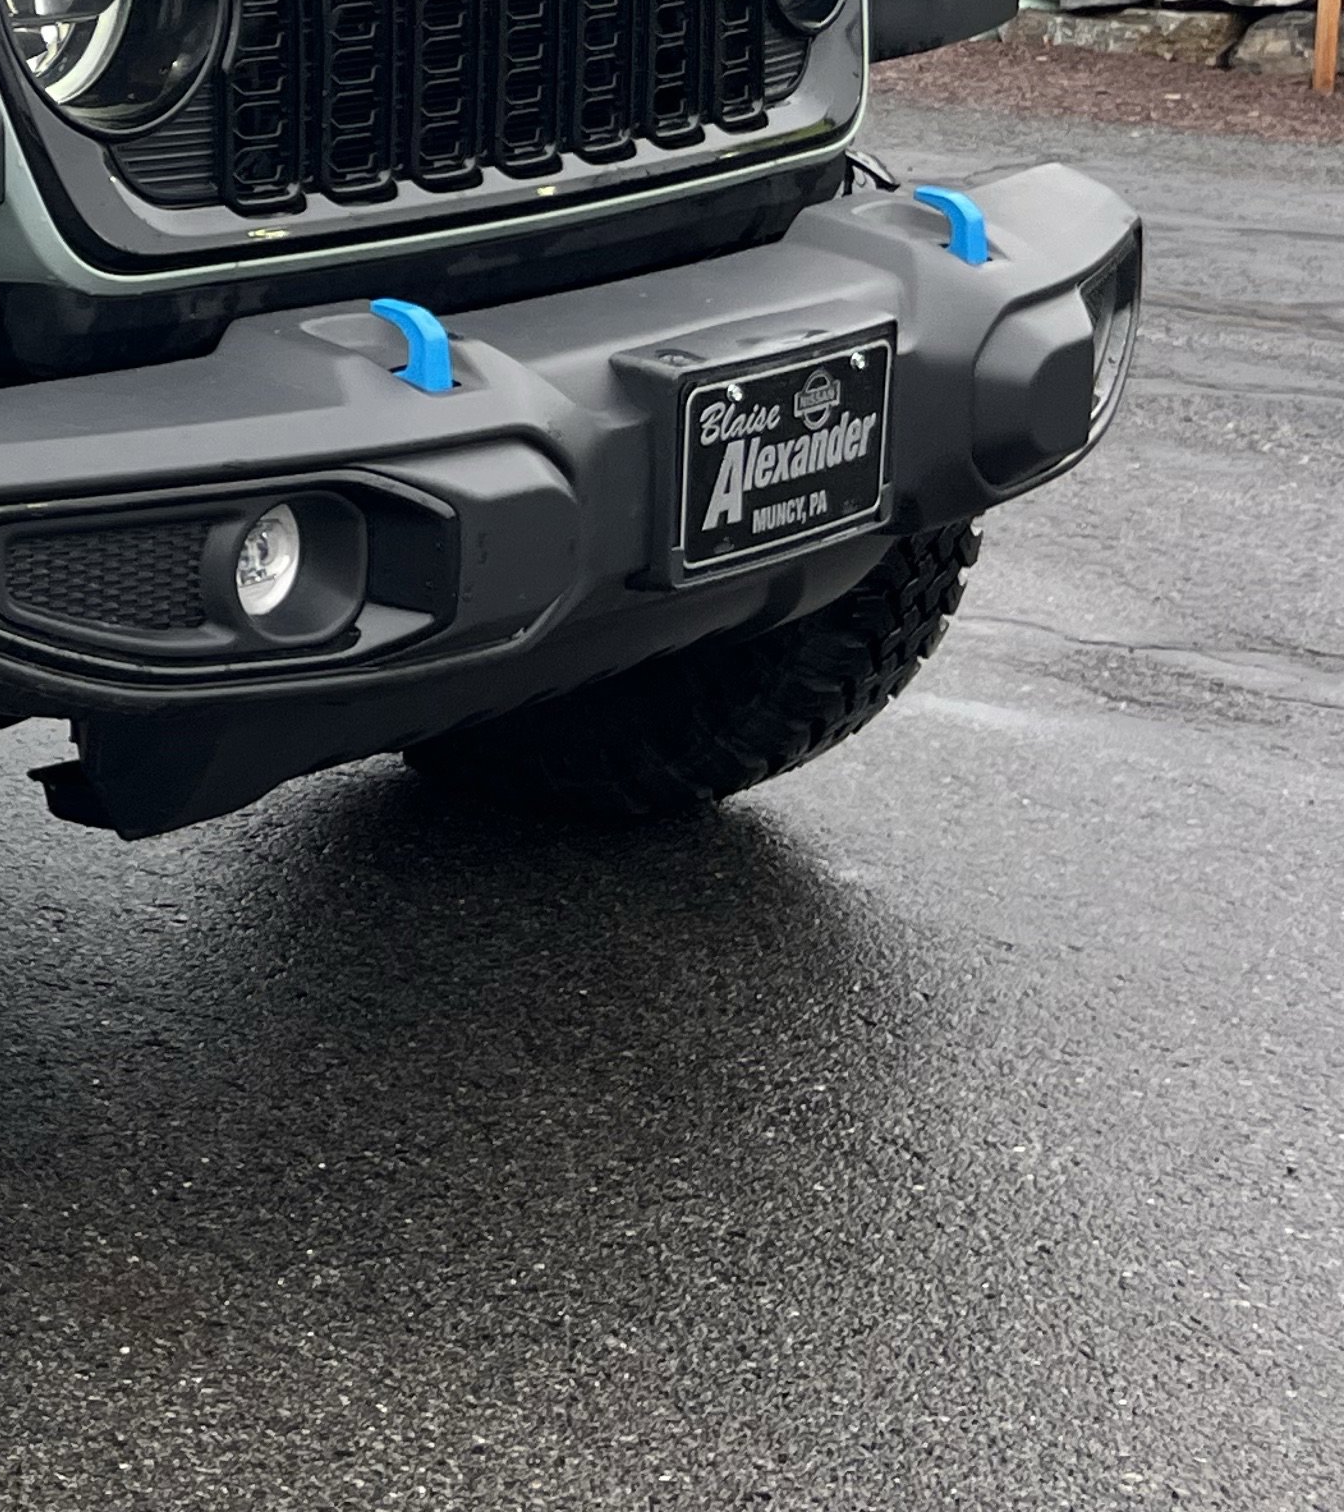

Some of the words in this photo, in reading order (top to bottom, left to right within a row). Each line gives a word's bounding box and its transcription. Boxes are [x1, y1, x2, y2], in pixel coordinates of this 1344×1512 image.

[700, 400, 781, 446] Blaise
[701, 411, 877, 531] Alexander
[752, 496, 807, 534] MUNCY,
[809, 489, 828, 517] PA
